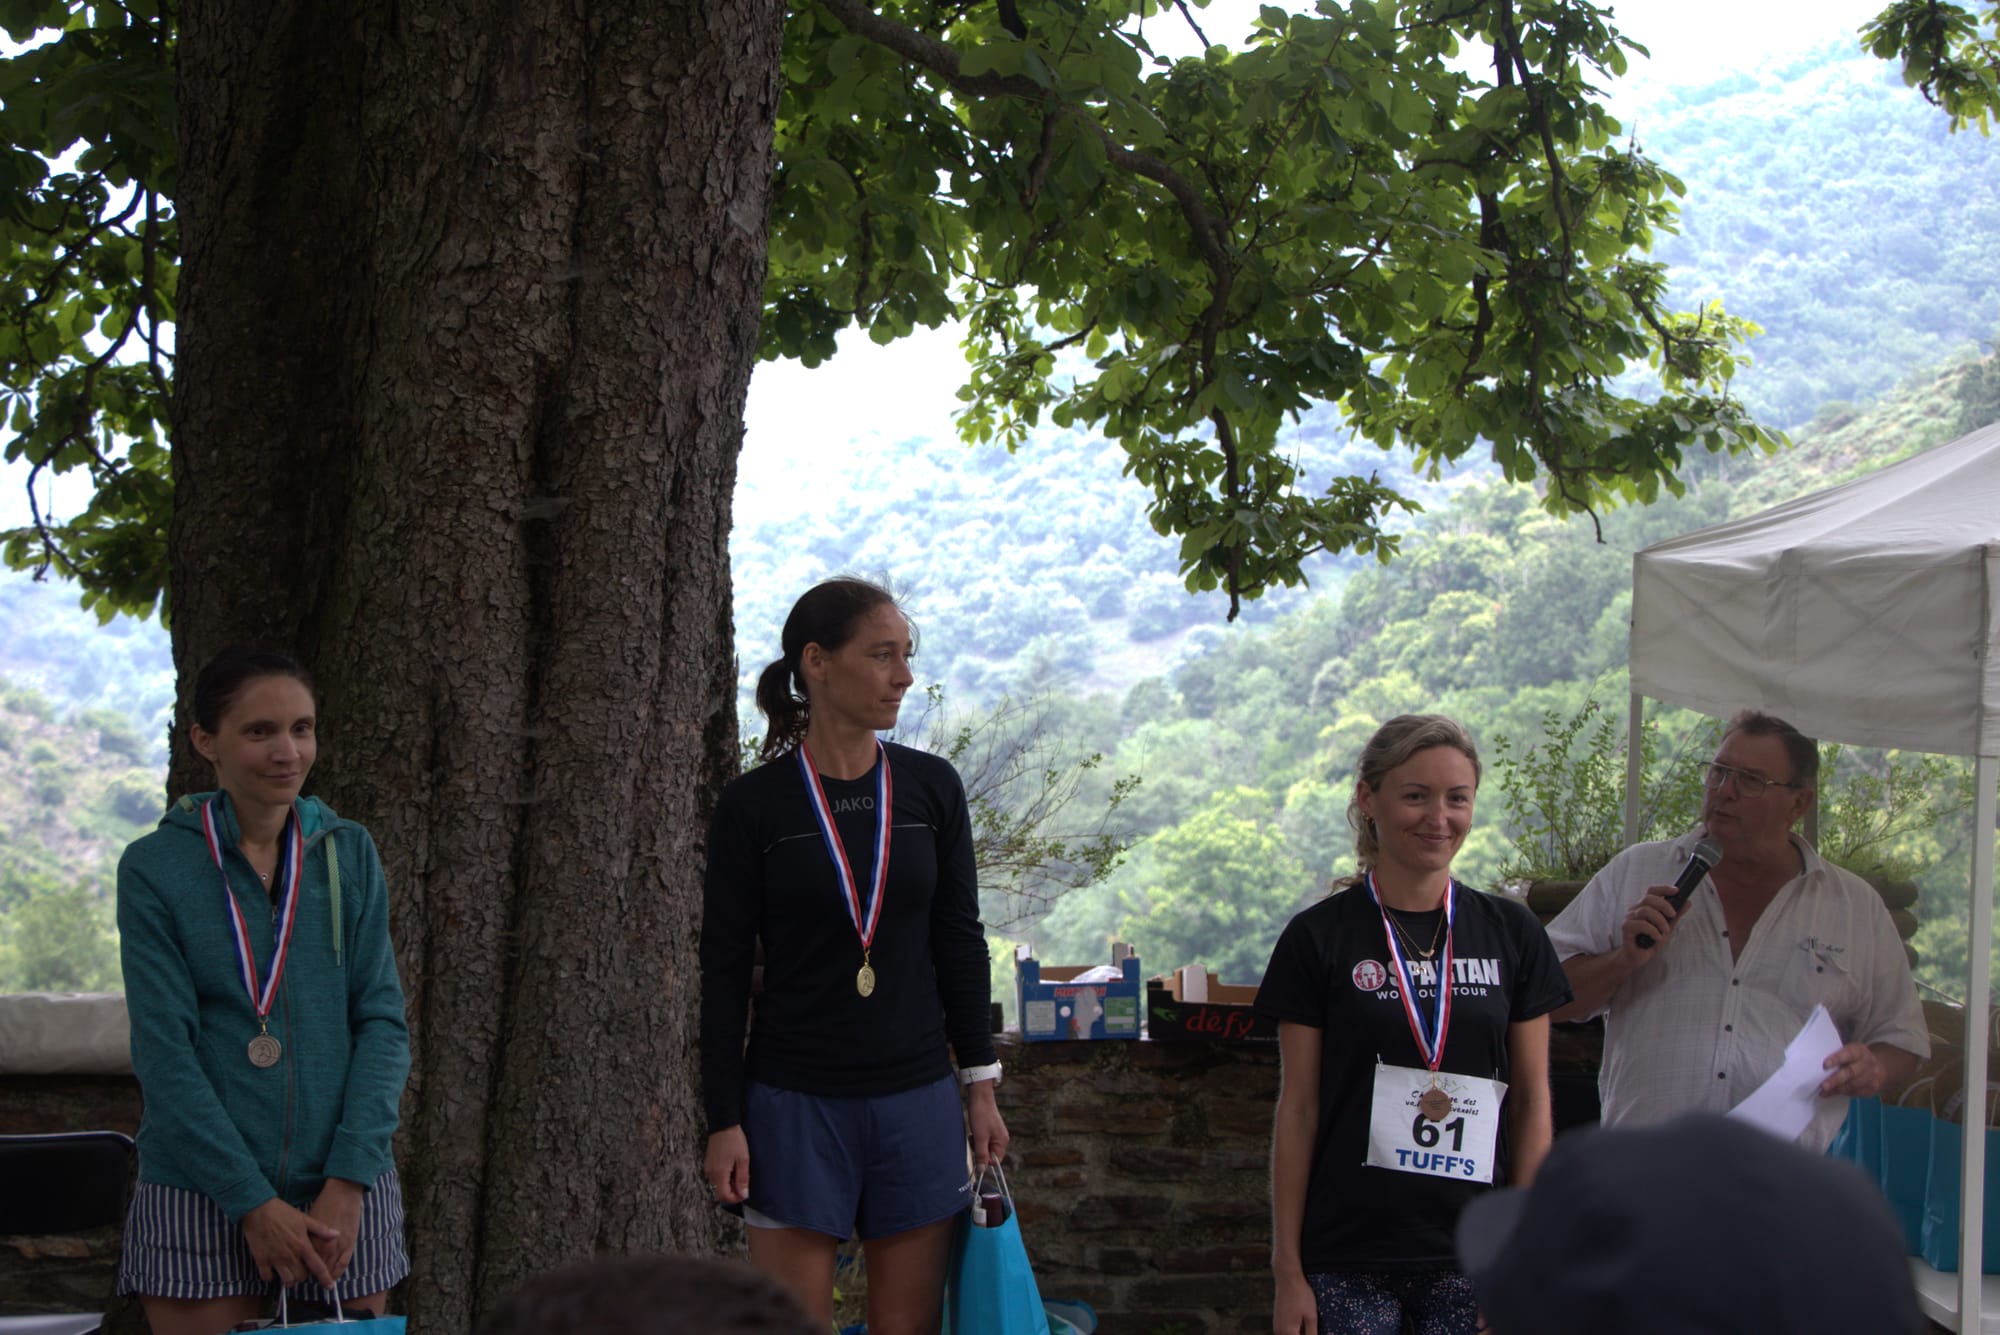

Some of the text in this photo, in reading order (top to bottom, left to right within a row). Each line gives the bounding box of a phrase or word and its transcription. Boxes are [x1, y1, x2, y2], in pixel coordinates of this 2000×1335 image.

[832, 796, 874, 813] JAKO
[1388, 958, 1500, 986] SPATAN
[1451, 987, 1488, 997] TOUR
[1412, 1113, 1464, 1152] 61
[1396, 1149, 1475, 1176] TUFF'S
